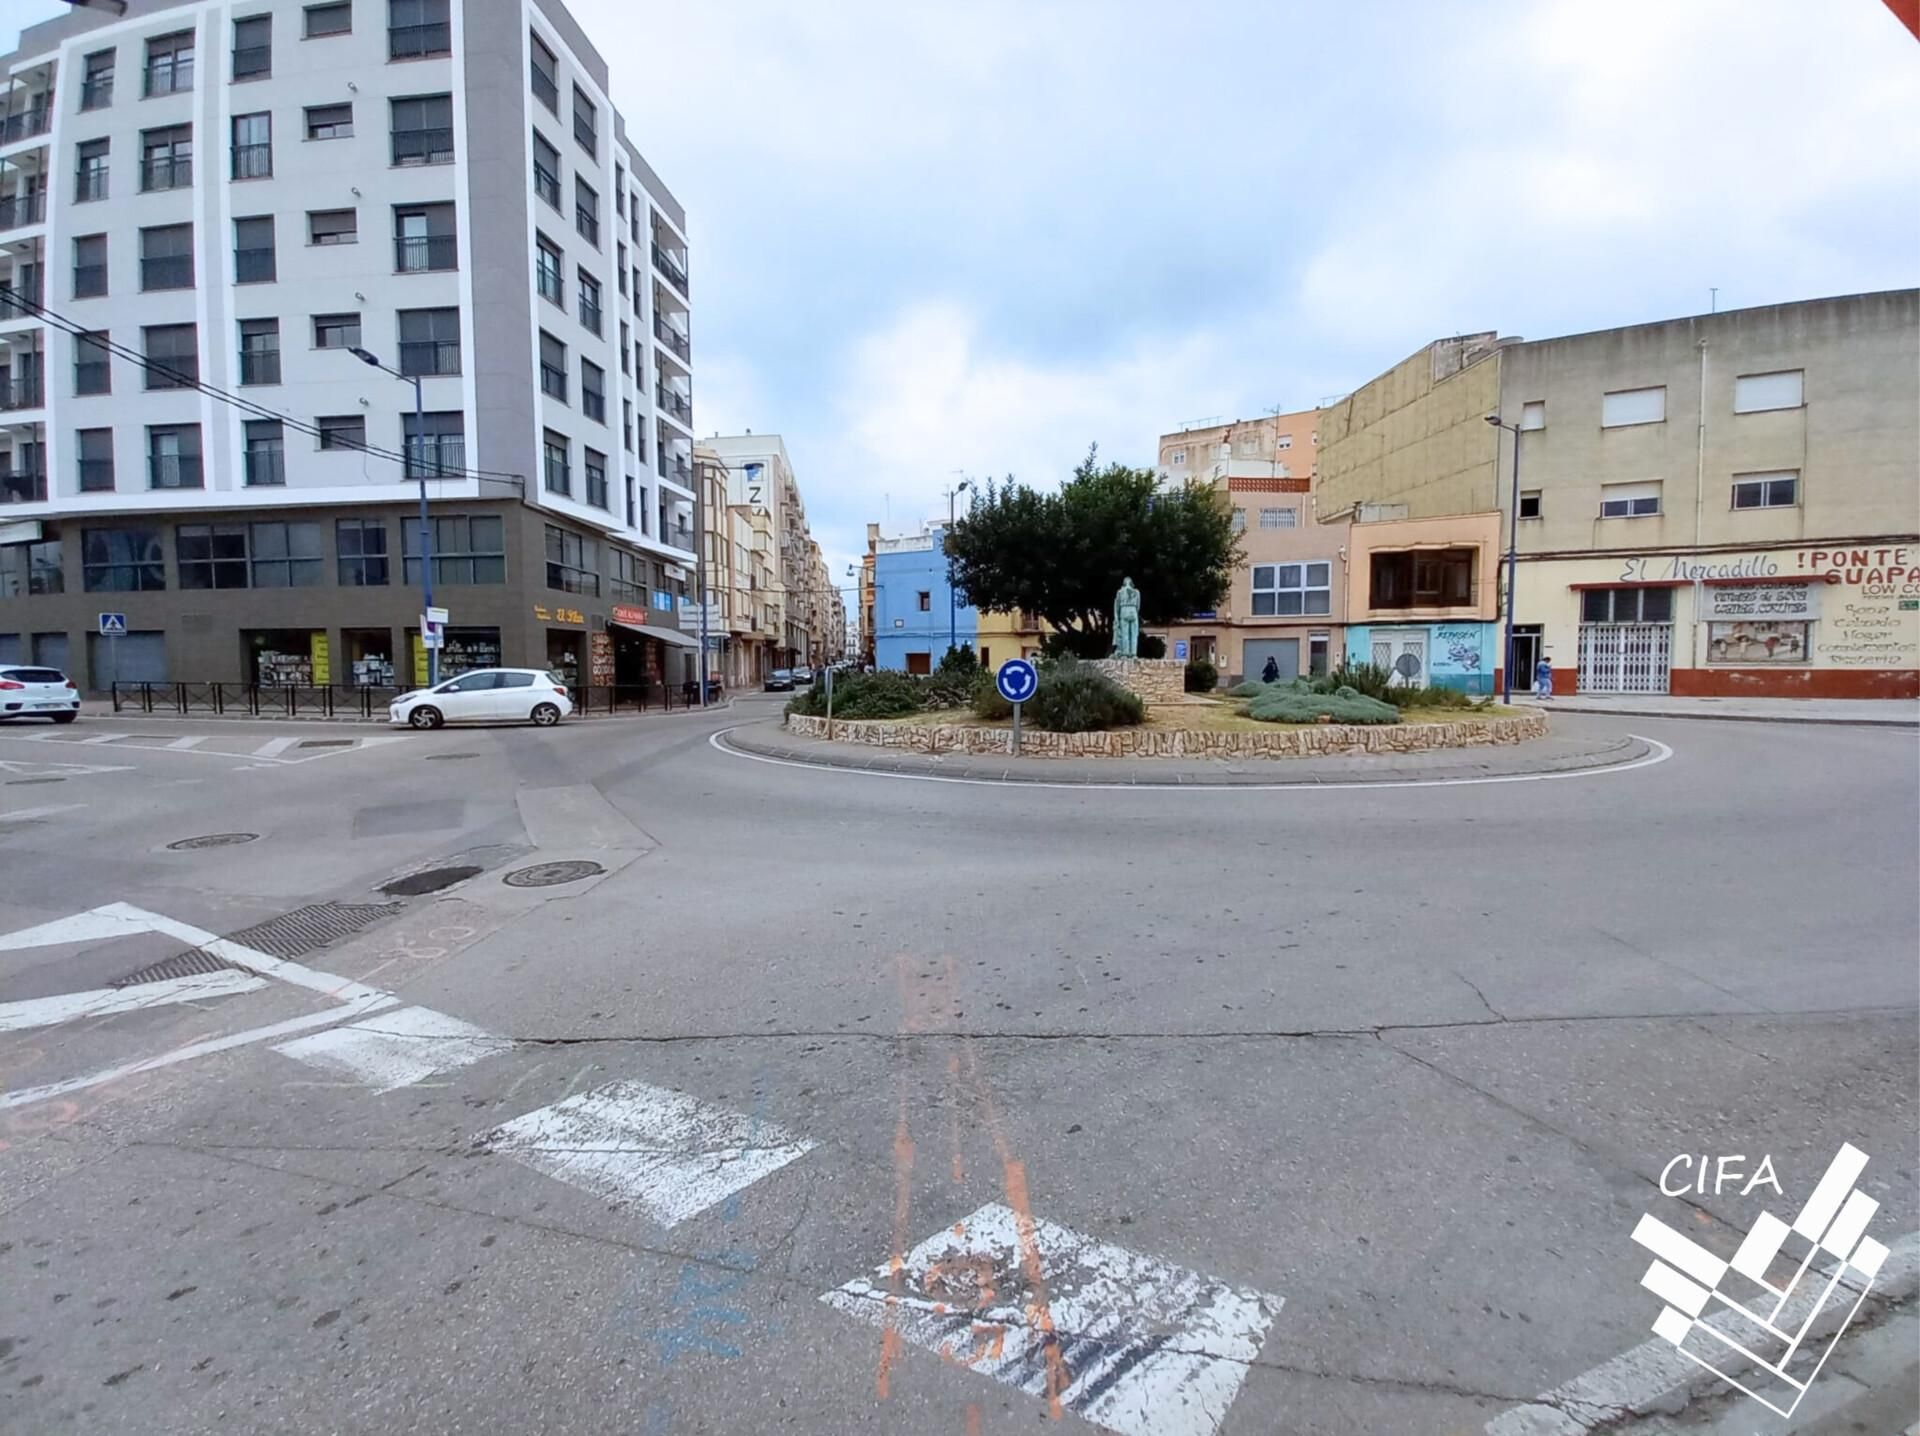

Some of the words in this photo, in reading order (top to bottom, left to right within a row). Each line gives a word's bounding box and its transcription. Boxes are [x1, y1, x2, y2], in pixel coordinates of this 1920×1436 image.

[1619, 556, 1647, 583] El
[1660, 554, 1778, 581] Mercadillo
[1862, 585, 1897, 595] LOW
